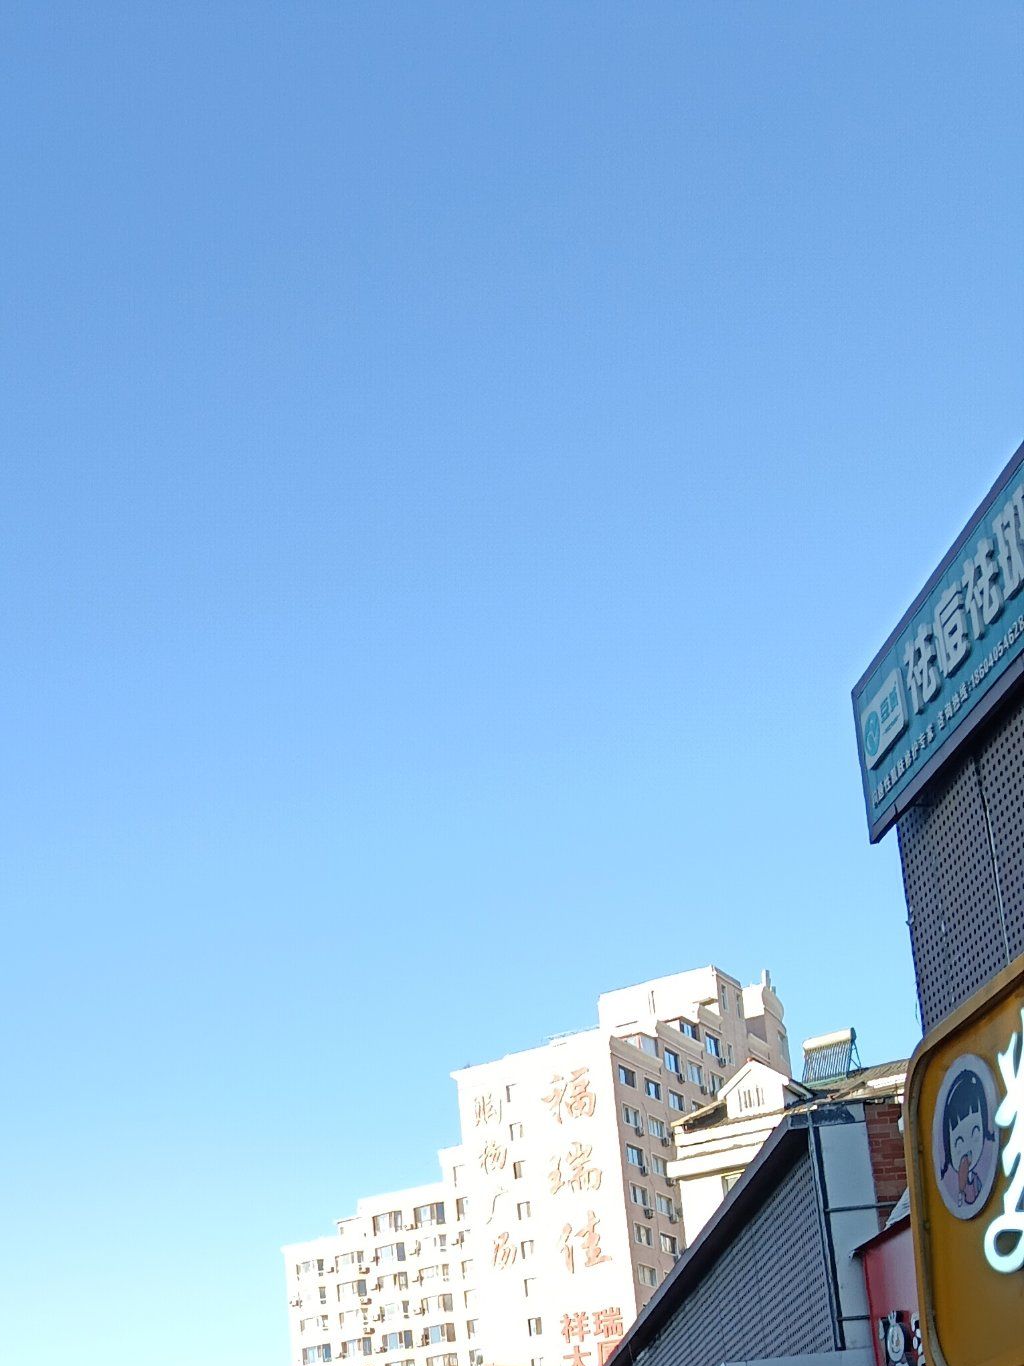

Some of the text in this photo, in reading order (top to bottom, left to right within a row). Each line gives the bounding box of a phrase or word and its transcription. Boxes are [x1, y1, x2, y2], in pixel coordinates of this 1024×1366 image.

[473, 1092, 517, 1271] 购物广场
[541, 1067, 612, 1274] 福瑞佳
[560, 1307, 624, 1343] 祥瑞
